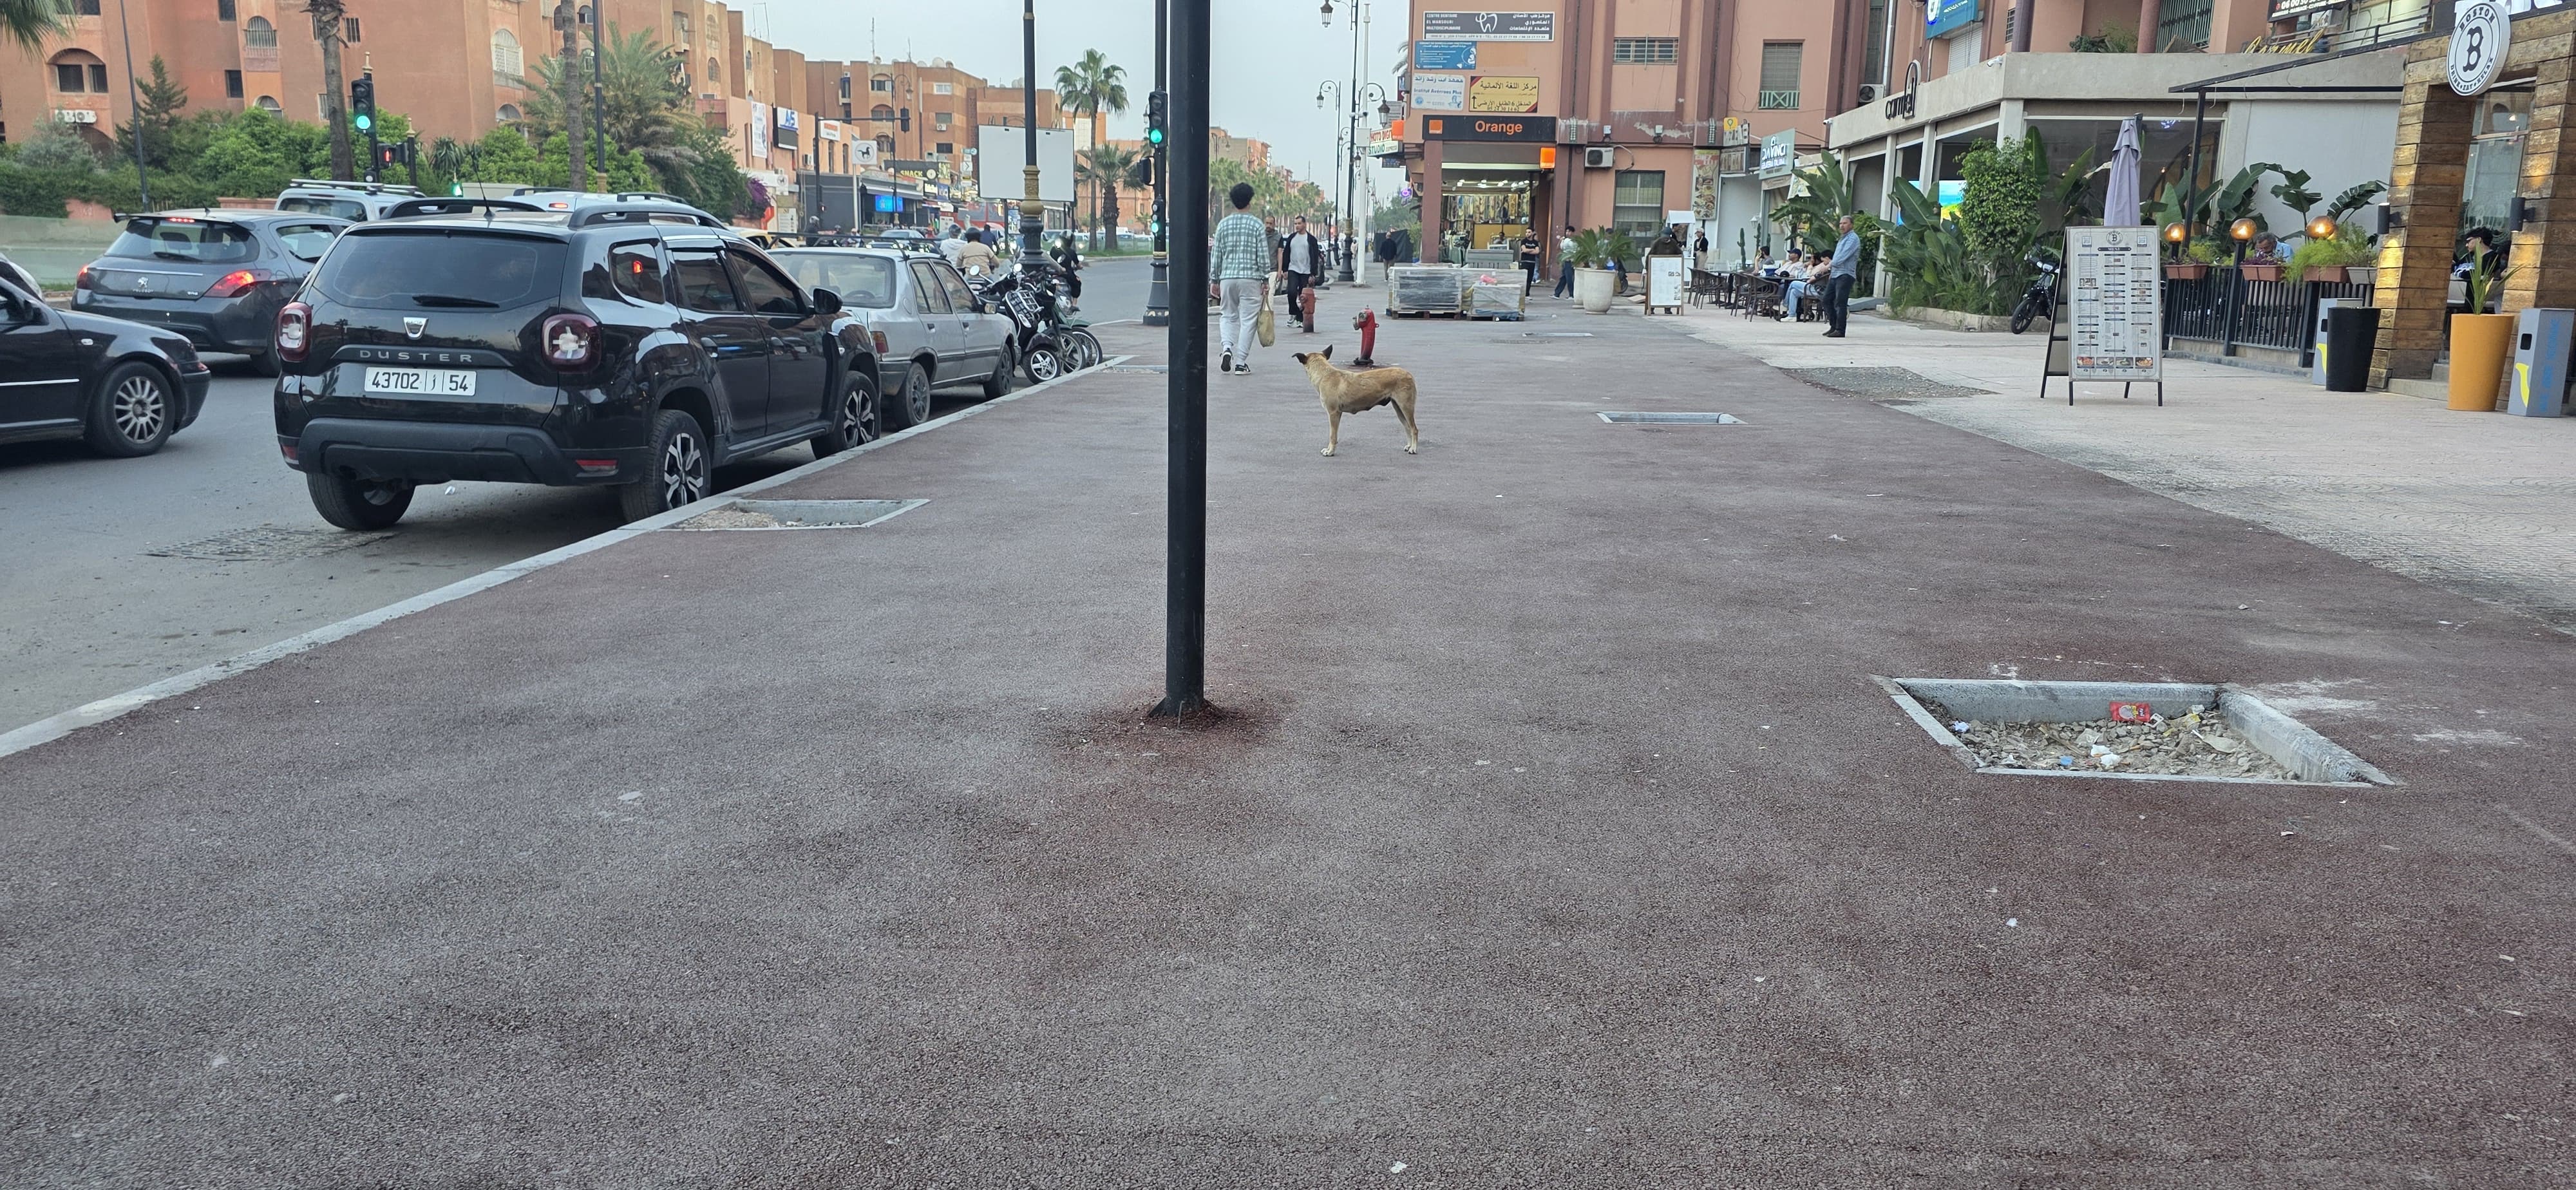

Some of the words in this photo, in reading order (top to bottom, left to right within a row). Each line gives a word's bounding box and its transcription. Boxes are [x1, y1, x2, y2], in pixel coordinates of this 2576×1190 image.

[2459, 6, 2496, 32] BOSTON
[2462, 26, 2484, 73] B
[2476, 57, 2494, 85] RELAX
[1480, 80, 1504, 90] الألمانية
[1475, 120, 1523, 135] Orange
[1368, 144, 1385, 155] STUDIO
[359, 350, 472, 363] DUSTER
[372, 372, 420, 390] 43702
[449, 374, 468, 392] 54
